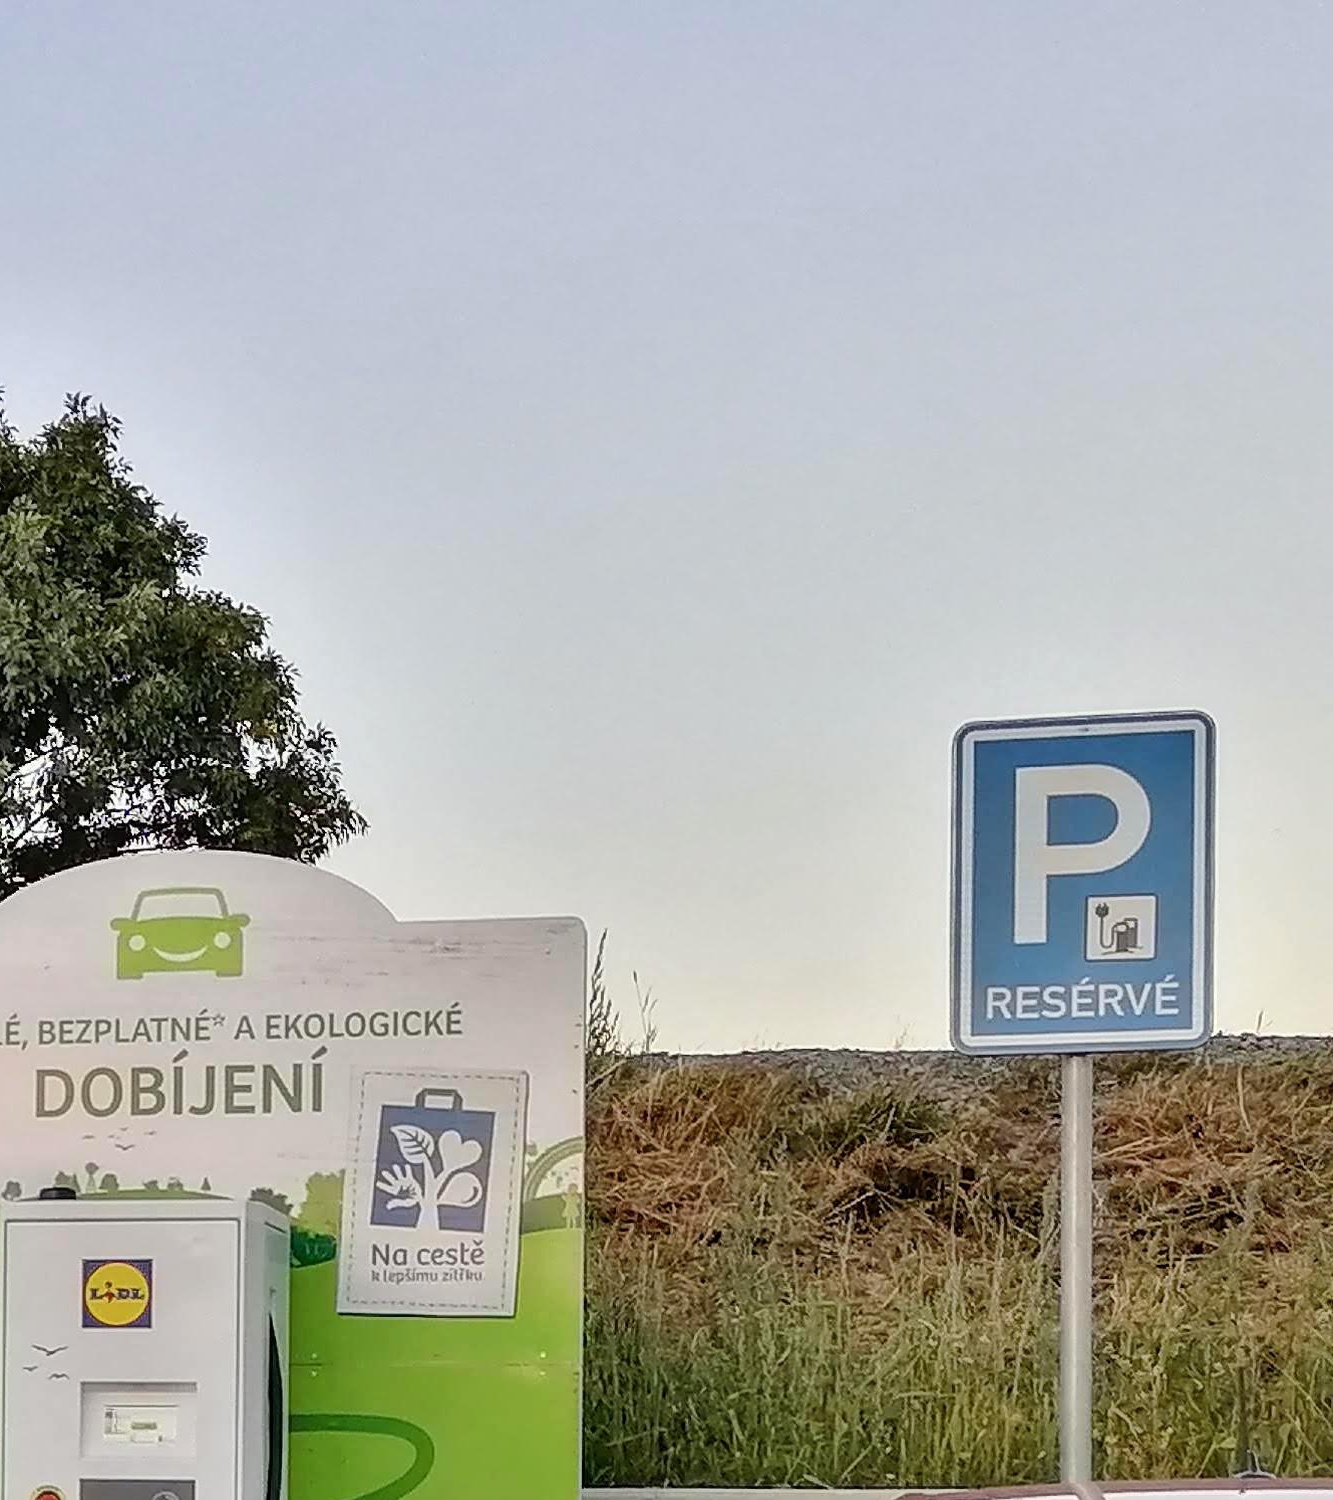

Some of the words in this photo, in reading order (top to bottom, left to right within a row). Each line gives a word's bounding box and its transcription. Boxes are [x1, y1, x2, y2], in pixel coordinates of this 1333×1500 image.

[1013, 763, 1151, 945] P
[986, 974, 1179, 1020] RESÉRVÉ
[234, 1015, 255, 1040] A
[266, 1002, 463, 1040] EKOLOGICKÉ
[35, 1045, 328, 1118] DOBÍJENÍ
[371, 1243, 408, 1267] Na
[417, 1240, 485, 1267] cestě
[371, 1270, 381, 1283] k
[383, 1268, 438, 1285] lepšímu
